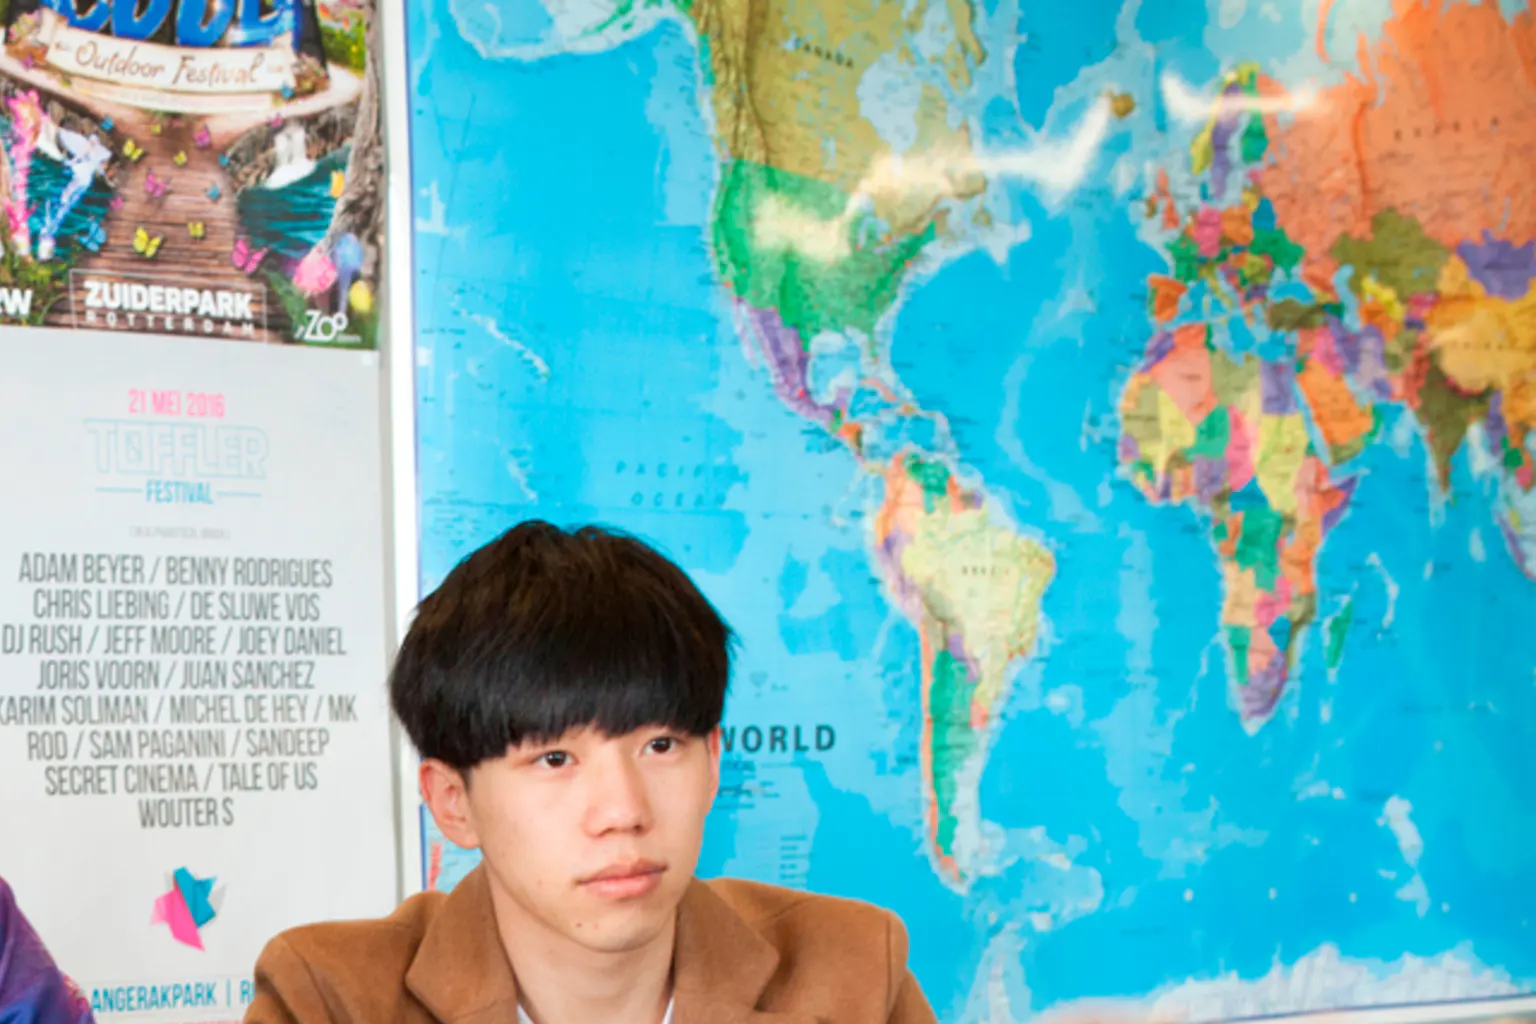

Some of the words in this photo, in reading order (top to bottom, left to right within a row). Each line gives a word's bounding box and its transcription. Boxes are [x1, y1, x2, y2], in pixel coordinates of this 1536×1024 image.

[74, 40, 165, 78] Outdoor
[171, 52, 265, 86] Festival
[83, 280, 254, 319] ZUIDERPARK
[86, 310, 255, 336] ROTTERDAM
[128, 388, 147, 414] 21
[152, 389, 181, 415] MEI
[186, 392, 227, 419] 2016
[146, 479, 215, 505] FESTIVAL
[18, 552, 77, 583] ADAM
[83, 553, 145, 584] BEYER
[166, 555, 228, 586] BENNY
[234, 557, 333, 588] RODRIGUES
[33, 588, 92, 619] CHRIS
[97, 589, 169, 619] LIEBING
[191, 591, 215, 620] DE
[219, 591, 281, 620] SLUWE
[286, 592, 320, 621] VOS
[2, 624, 24, 654] DJ
[29, 624, 82, 654] RUSH
[104, 625, 147, 655] JEFF
[150, 625, 216, 655] MOORE
[237, 626, 279, 655] JOEY
[284, 627, 346, 655] DANIEL
[37, 660, 90, 690] JORIS
[95, 660, 159, 689] VOORN
[180, 660, 227, 689] JUAN
[232, 660, 315, 689] SANCHEZ
[62, 695, 148, 725] SOLIMAN
[170, 694, 241, 724] MICHEL
[244, 694, 268, 723] DE
[272, 694, 308, 723] HEY
[328, 694, 358, 722] MK
[27, 731, 68, 760] ROD
[89, 729, 133, 759] SAM
[138, 729, 226, 759] PAGANINI
[246, 727, 329, 757] SANDEEP
[44, 765, 118, 796] SECRET
[124, 764, 198, 794] CINEMA
[219, 762, 263, 792] TALE
[267, 762, 289, 791] OF
[294, 761, 318, 791] US
[138, 798, 218, 828] WOUTER
[222, 796, 234, 826] S
[91, 981, 217, 1013] ANGERAKPARK
